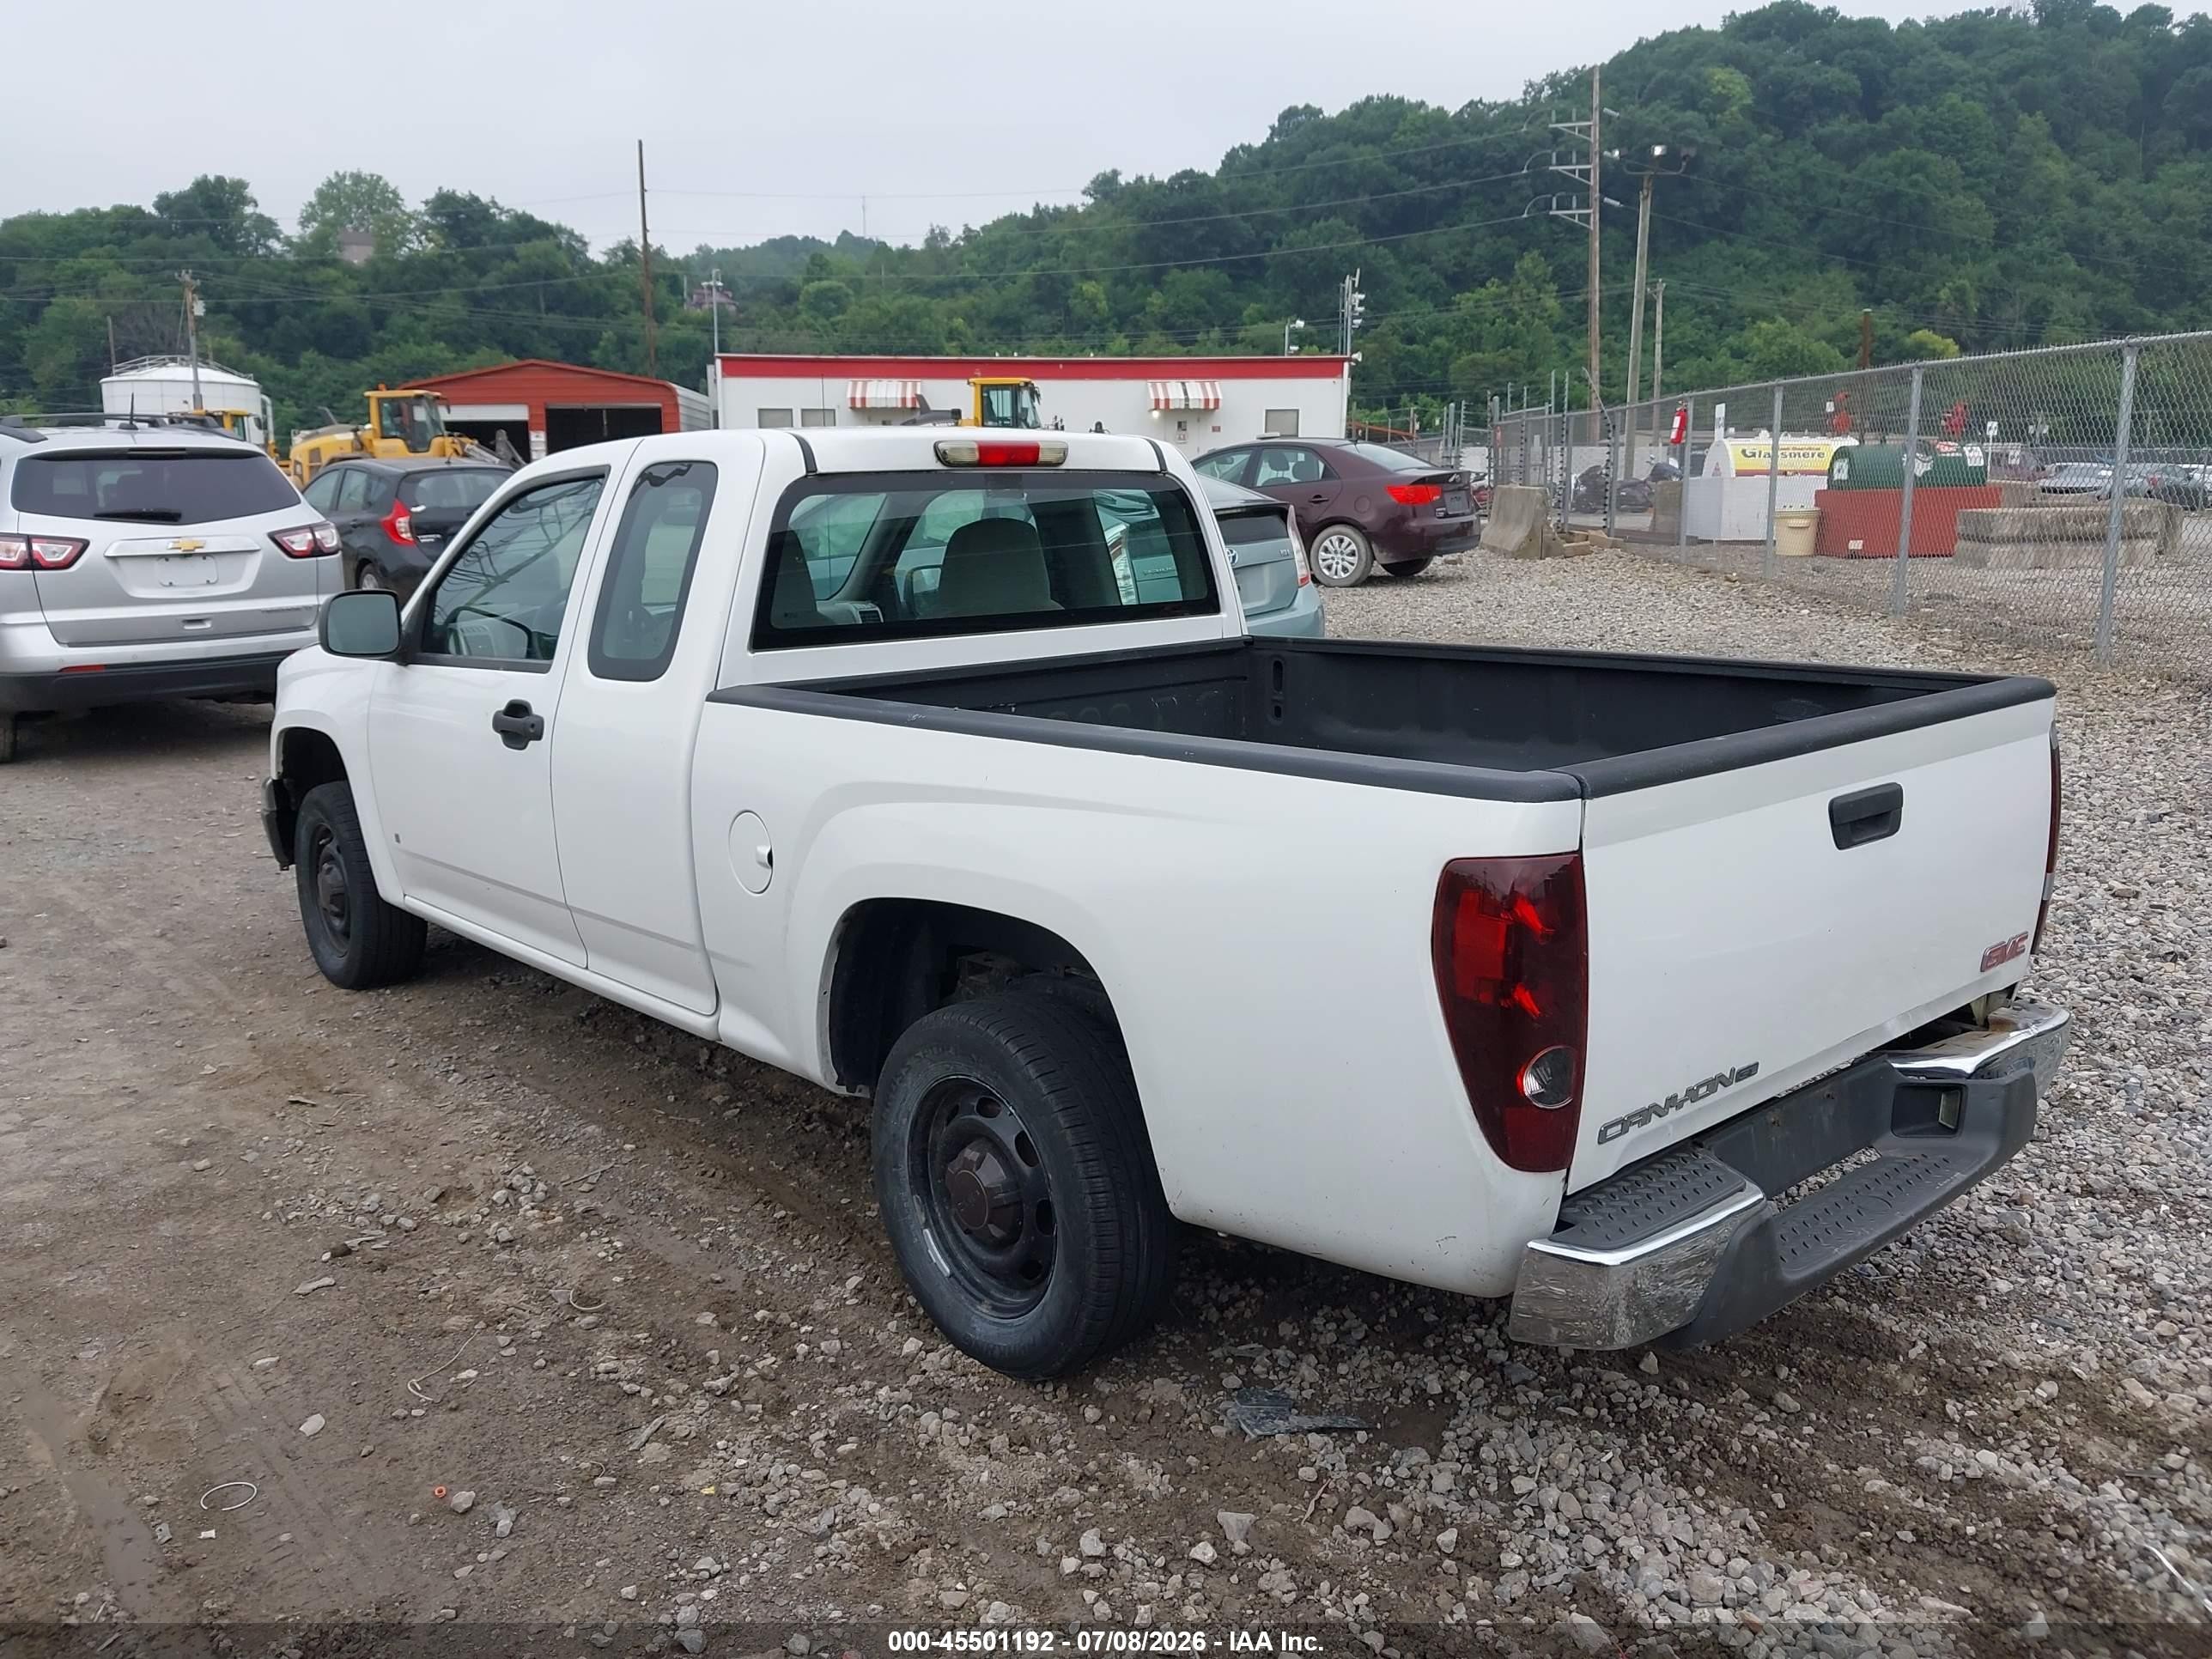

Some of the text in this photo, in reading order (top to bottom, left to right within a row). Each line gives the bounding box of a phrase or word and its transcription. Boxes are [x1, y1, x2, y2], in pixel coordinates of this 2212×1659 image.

[1741, 448, 1826, 459] Glasmere
[1980, 931, 2028, 972] GMC
[1598, 1066, 1735, 1145] CANYON
